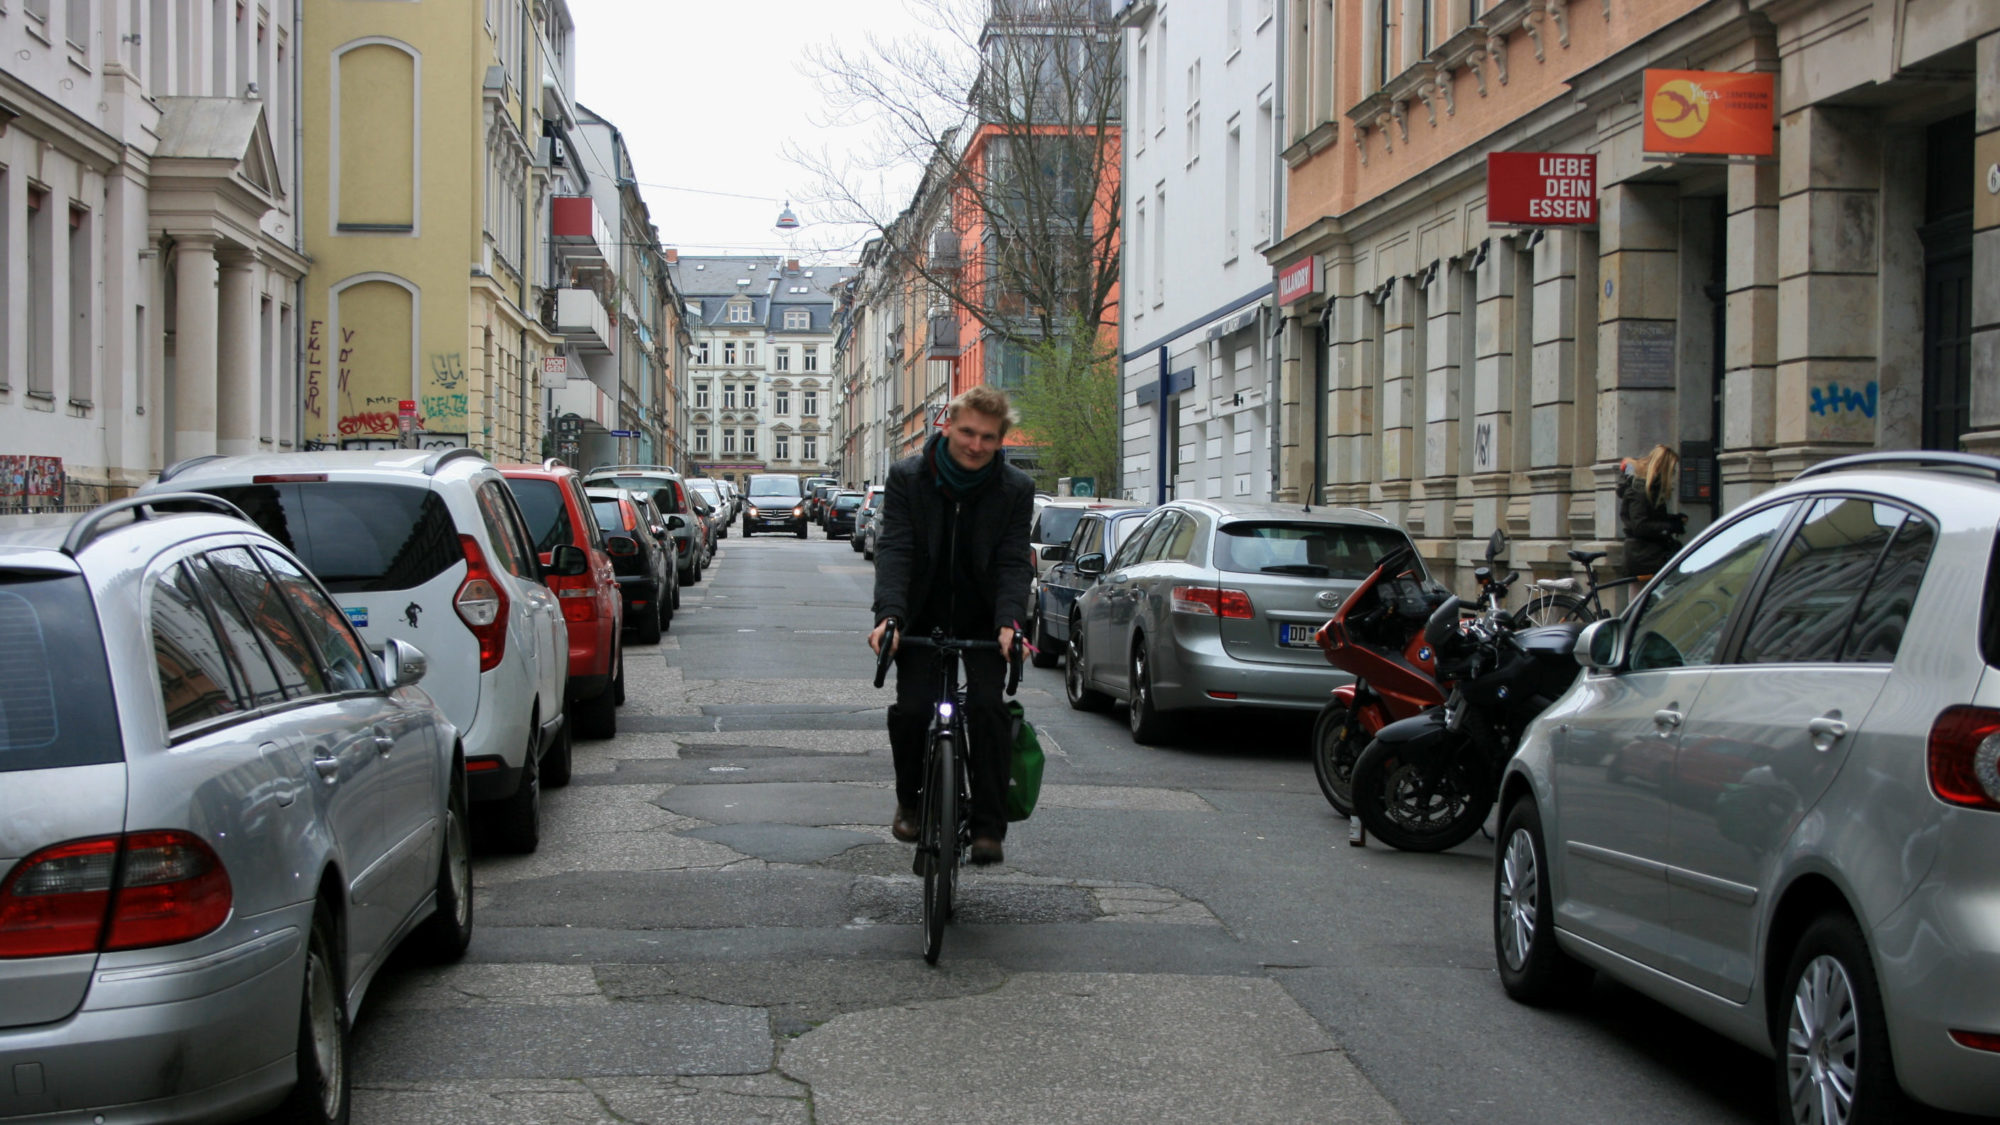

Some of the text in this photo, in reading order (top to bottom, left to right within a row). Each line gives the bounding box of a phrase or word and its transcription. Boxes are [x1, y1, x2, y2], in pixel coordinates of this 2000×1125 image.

[1539, 158, 1591, 177] LIEBE
[1546, 178, 1591, 198] DEIN
[1529, 199, 1591, 219] ESSEN
[1280, 265, 1309, 297] VILLANDRY
[1290, 627, 1306, 641] DD
